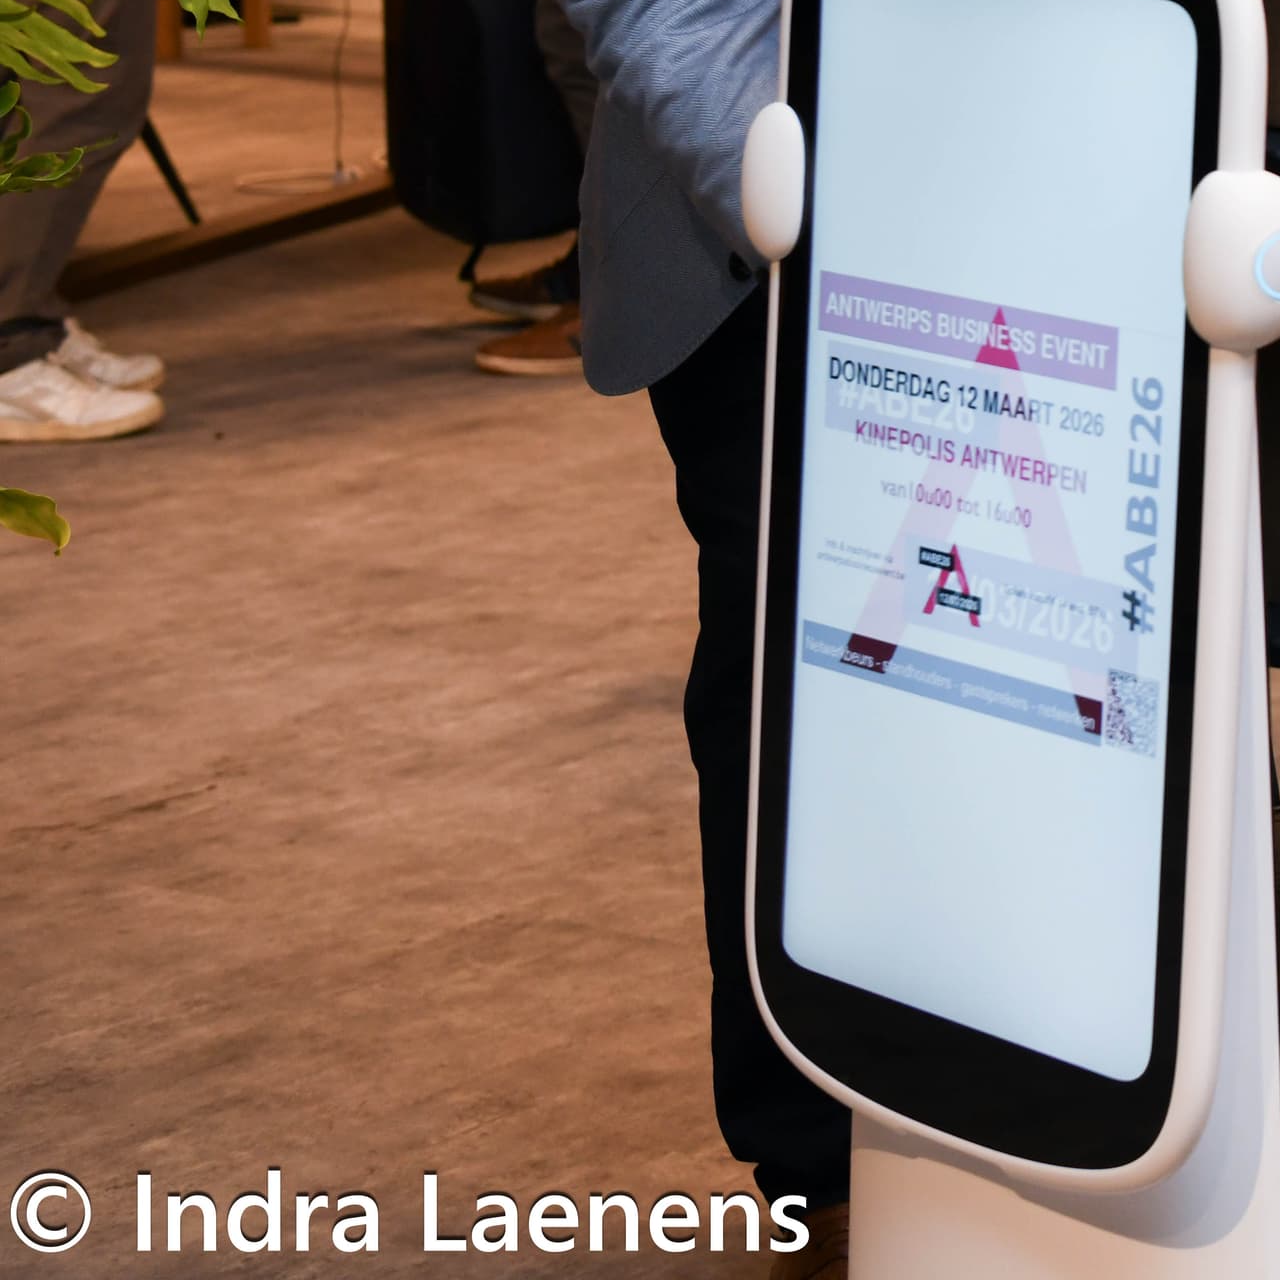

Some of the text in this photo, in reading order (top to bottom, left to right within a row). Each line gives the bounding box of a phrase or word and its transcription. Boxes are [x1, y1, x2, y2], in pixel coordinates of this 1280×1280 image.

[826, 291, 1110, 370] ANTWERPS BUSINESS EVENT
[829, 356, 1105, 438] DONDERDAG 12 MAART 2026
[855, 418, 1088, 495] KINEPOLIS ANTWERPEN
[881, 479, 1033, 529] van 10u00 tot 16u00
[1121, 376, 1164, 634] #ABE26
